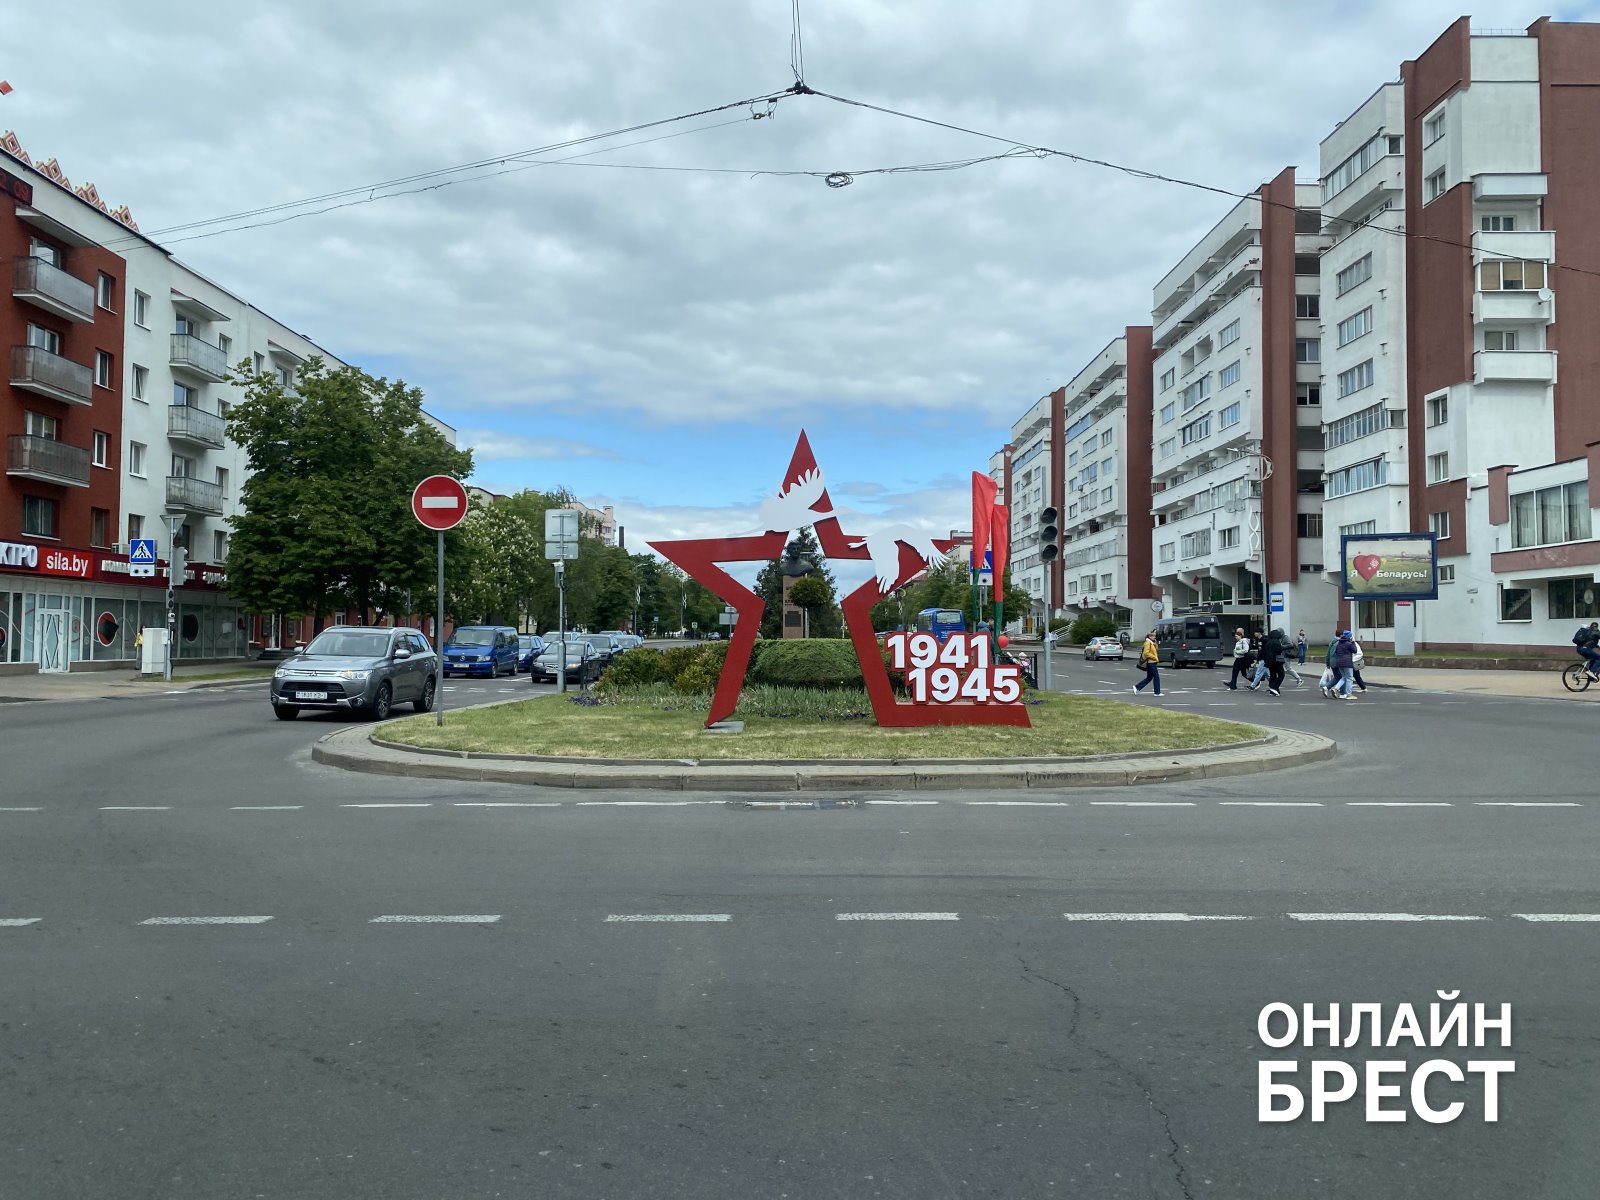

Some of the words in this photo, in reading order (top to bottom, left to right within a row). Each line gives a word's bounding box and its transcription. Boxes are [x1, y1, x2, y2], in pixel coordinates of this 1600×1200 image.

[46, 551, 88, 577] sila.by
[1376, 569, 1427, 579] Беларусь!
[887, 634, 988, 669] 1941
[908, 668, 1020, 702] 1945
